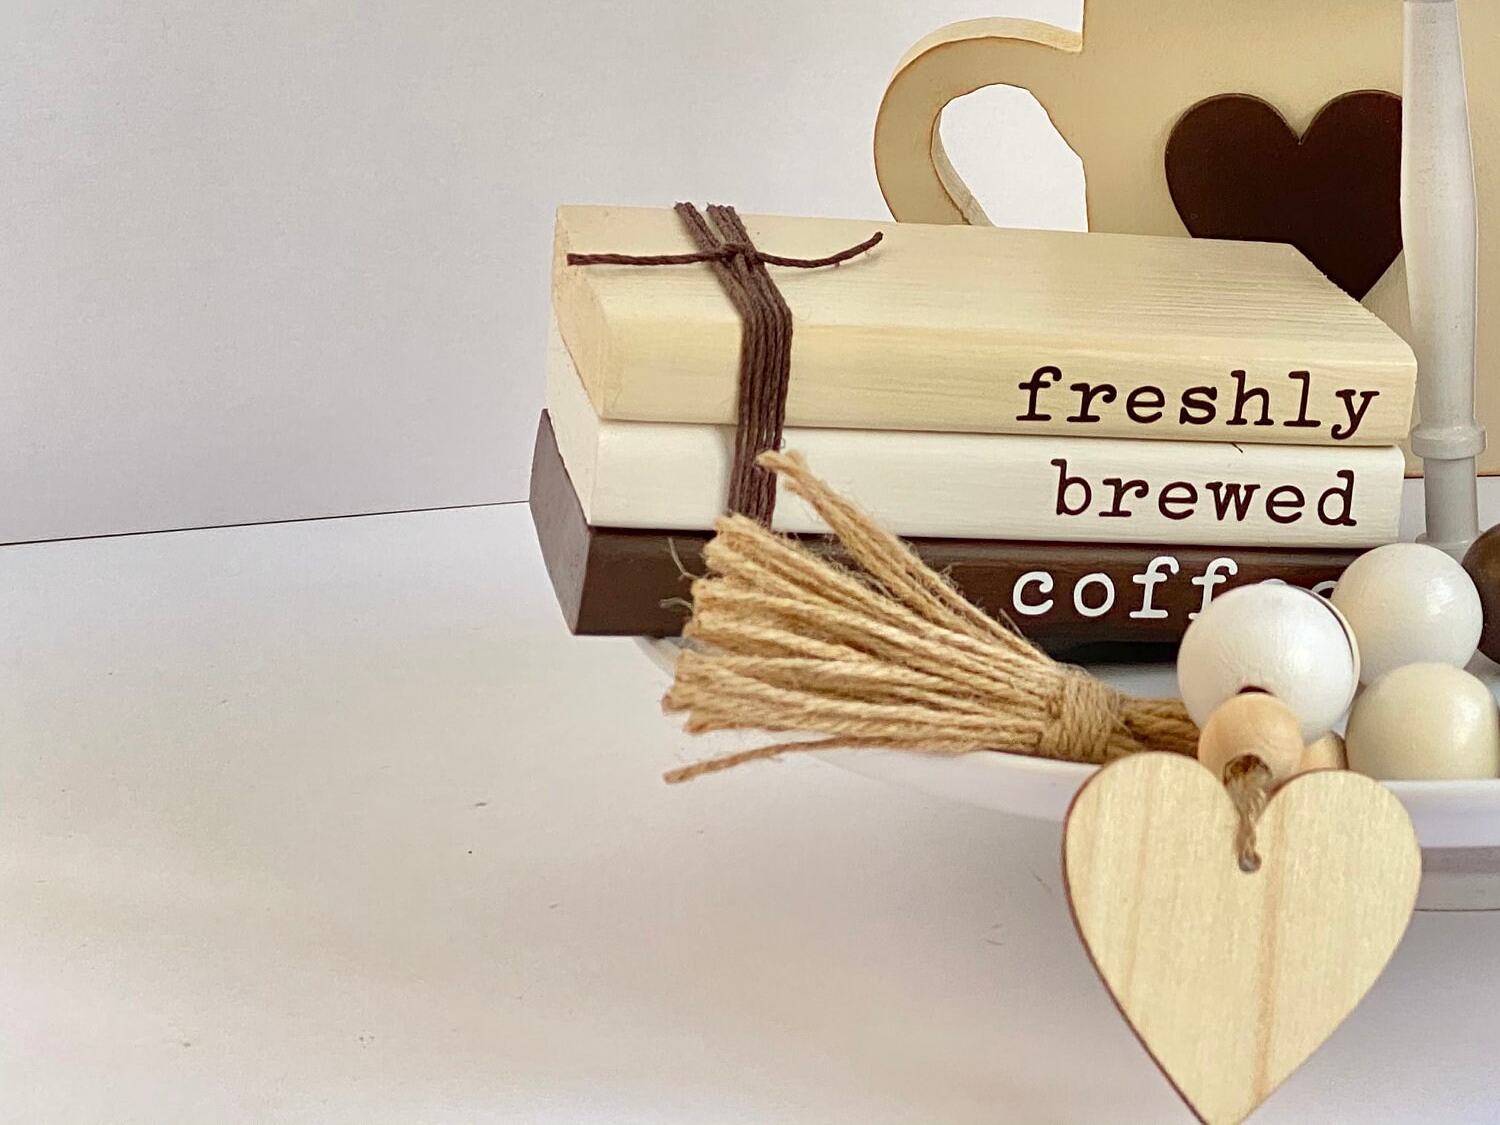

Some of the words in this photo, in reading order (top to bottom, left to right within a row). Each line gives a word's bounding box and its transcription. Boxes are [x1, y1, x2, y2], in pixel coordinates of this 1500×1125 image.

[1016, 365, 1380, 440] freshly
[1050, 458, 1357, 527] brewed
[1012, 555, 1337, 619] coff
